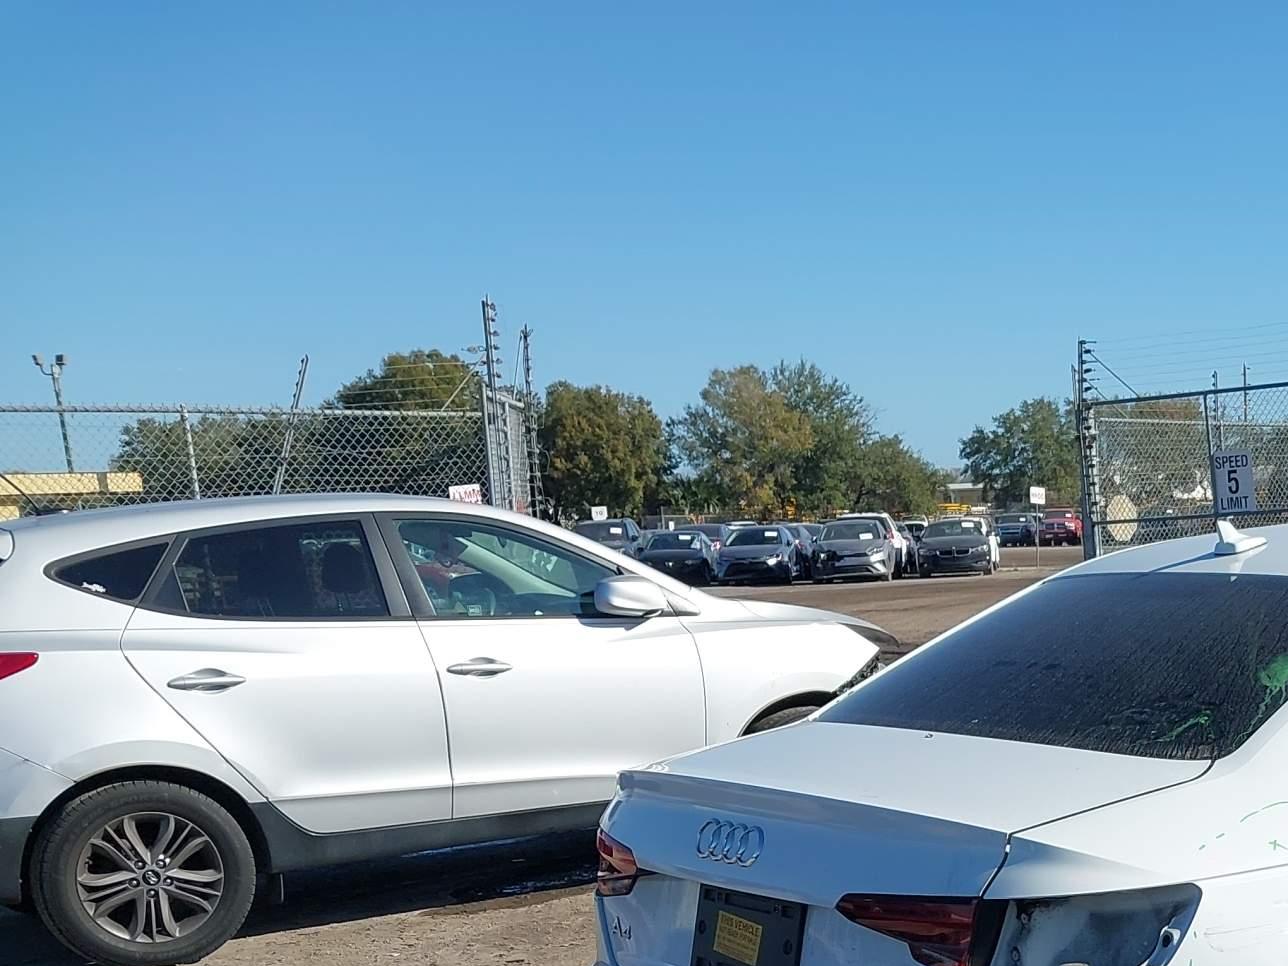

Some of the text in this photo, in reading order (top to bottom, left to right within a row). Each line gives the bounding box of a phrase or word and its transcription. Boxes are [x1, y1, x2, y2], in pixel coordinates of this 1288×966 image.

[1215, 455, 1248, 469] SPEED
[1227, 469, 1239, 494] 5
[1220, 496, 1249, 511] LIMIT
[612, 915, 632, 940] A4
[735, 920, 760, 937] VEHICLE
